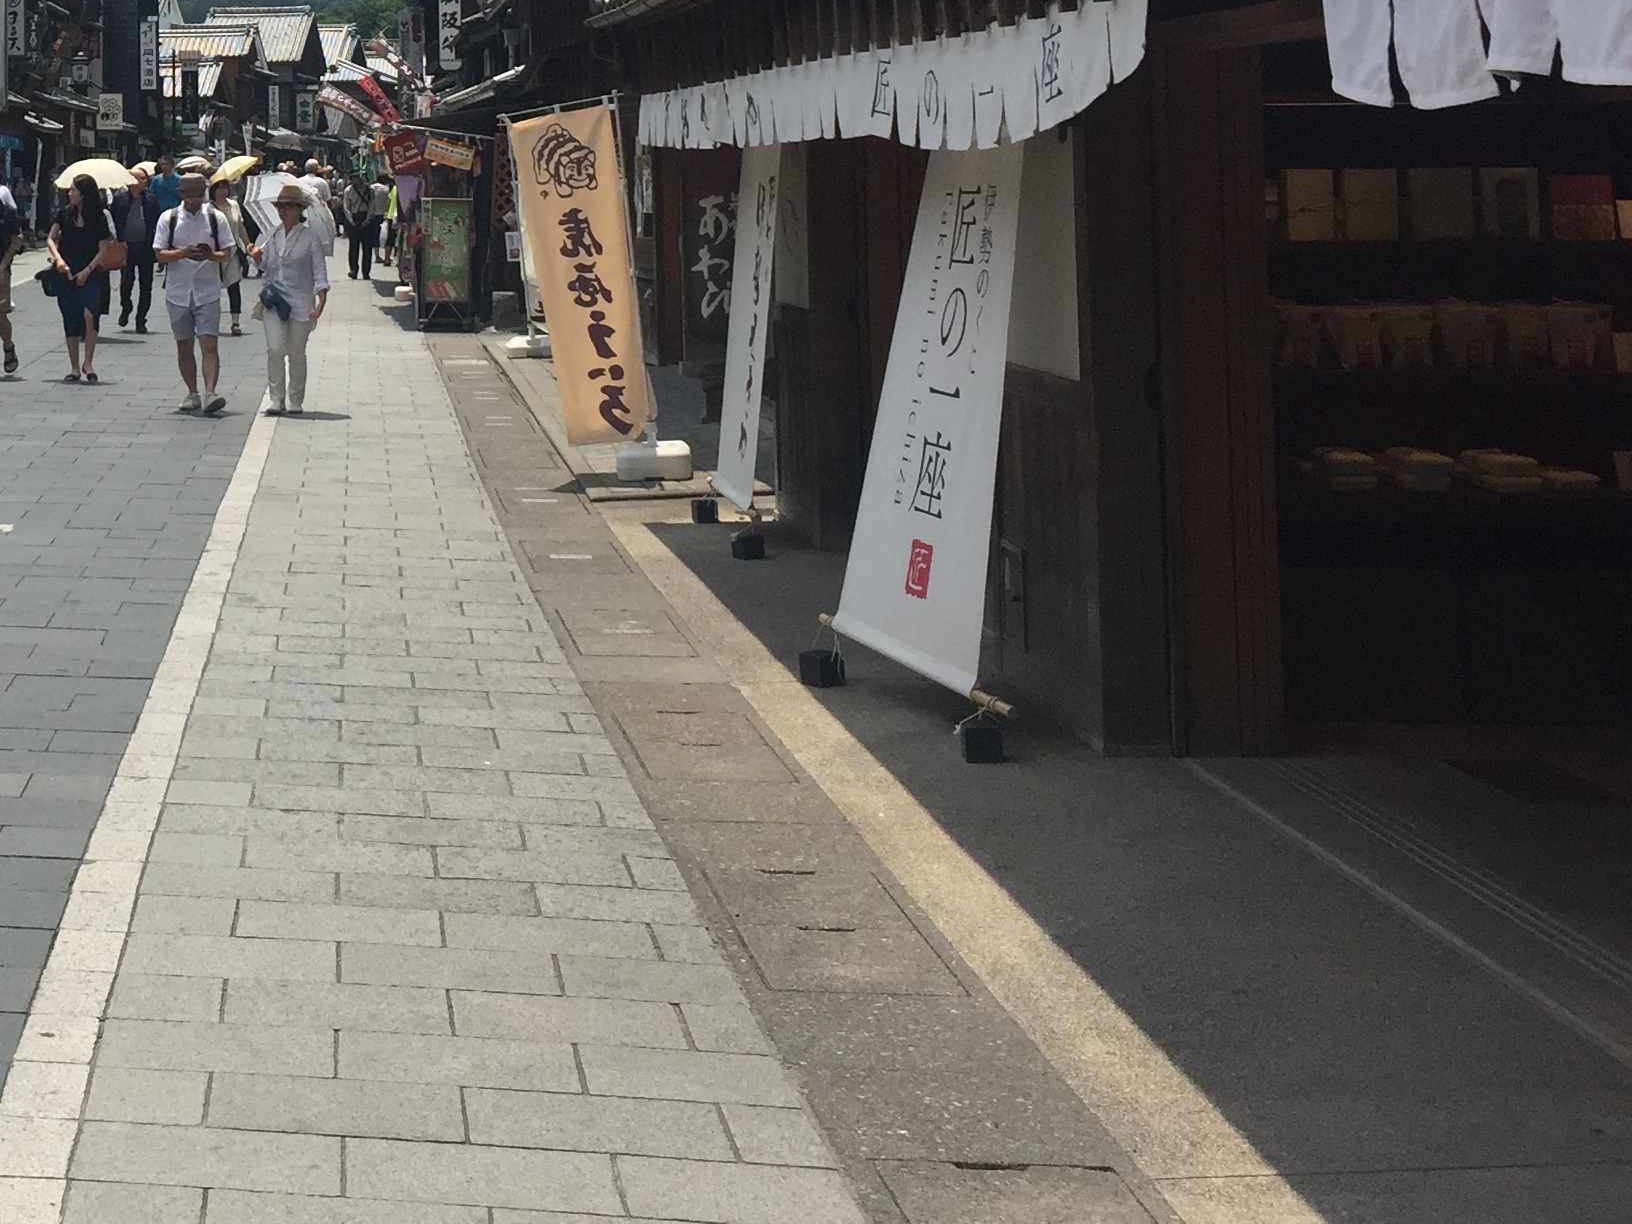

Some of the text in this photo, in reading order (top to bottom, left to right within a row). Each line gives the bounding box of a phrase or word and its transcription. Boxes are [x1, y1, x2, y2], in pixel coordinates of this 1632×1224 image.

[871, 23, 1062, 119] 匠の一座
[908, 185, 981, 520] 匠の一座
[917, 337, 929, 377] no
